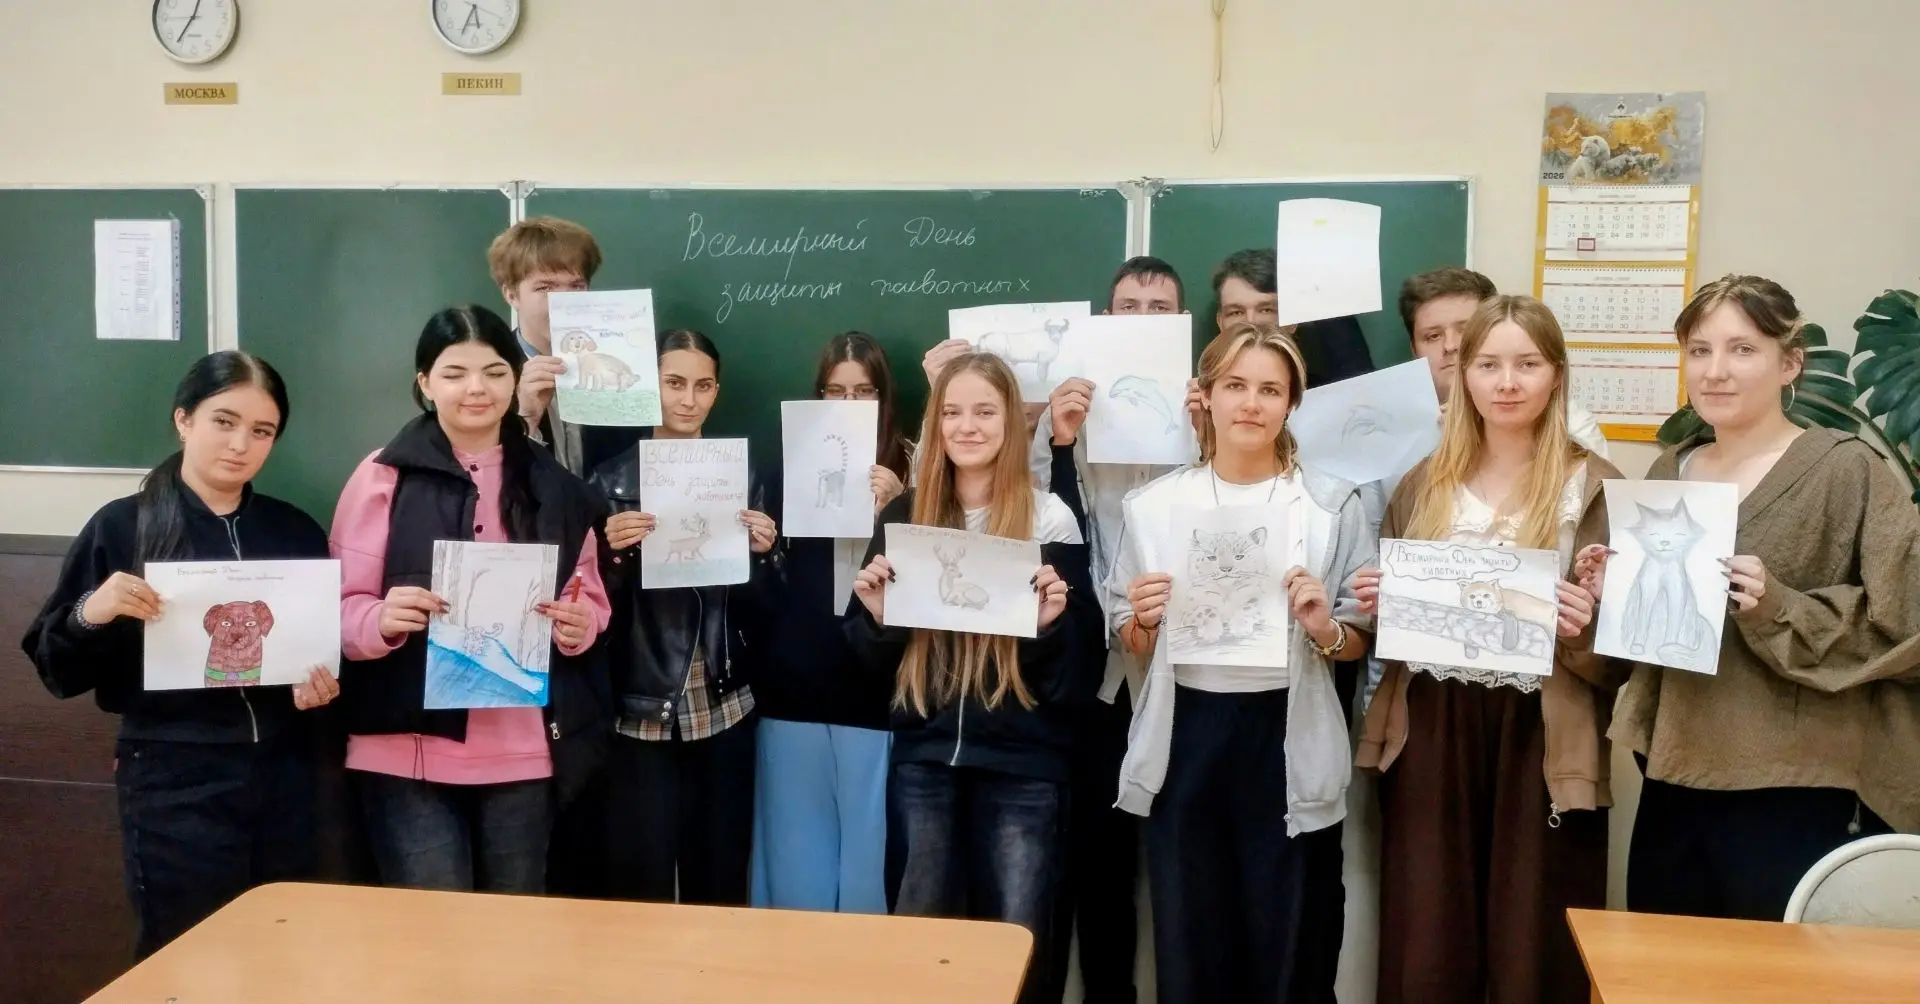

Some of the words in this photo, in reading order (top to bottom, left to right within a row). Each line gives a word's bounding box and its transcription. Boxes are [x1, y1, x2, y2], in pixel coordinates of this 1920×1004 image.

[457, 78, 504, 89] ПЕКИН
[174, 88, 226, 99] МОСКВА
[1543, 172, 1565, 180] 2026
[683, 211, 868, 281] Всемирный
[904, 216, 976, 248] День
[716, 281, 843, 324] защиты
[870, 269, 1031, 297] животных
